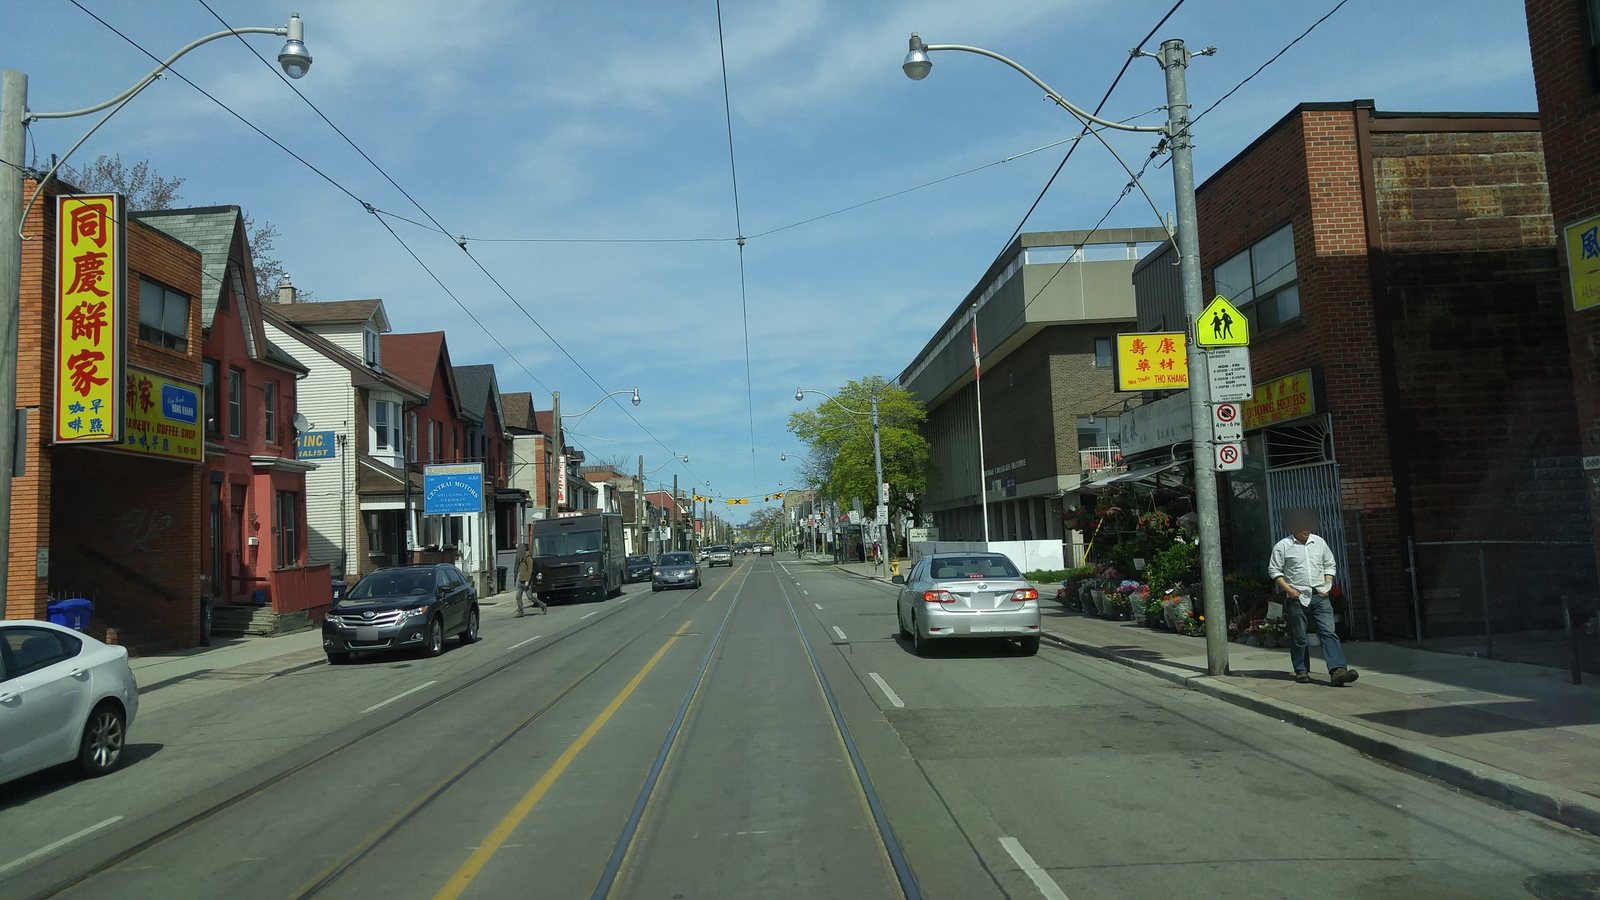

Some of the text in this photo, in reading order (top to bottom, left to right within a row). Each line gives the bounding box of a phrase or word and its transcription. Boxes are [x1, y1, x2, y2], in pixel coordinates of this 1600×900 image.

[65, 203, 110, 398] 同慶餅家
[1167, 373, 1187, 383] KHANG
[1277, 391, 1306, 411] HERBS
[157, 424, 179, 438] COFFEE
[180, 428, 196, 441] SHOP
[303, 434, 326, 448] INC.
[427, 481, 479, 500] CENTRAL MOTORS
